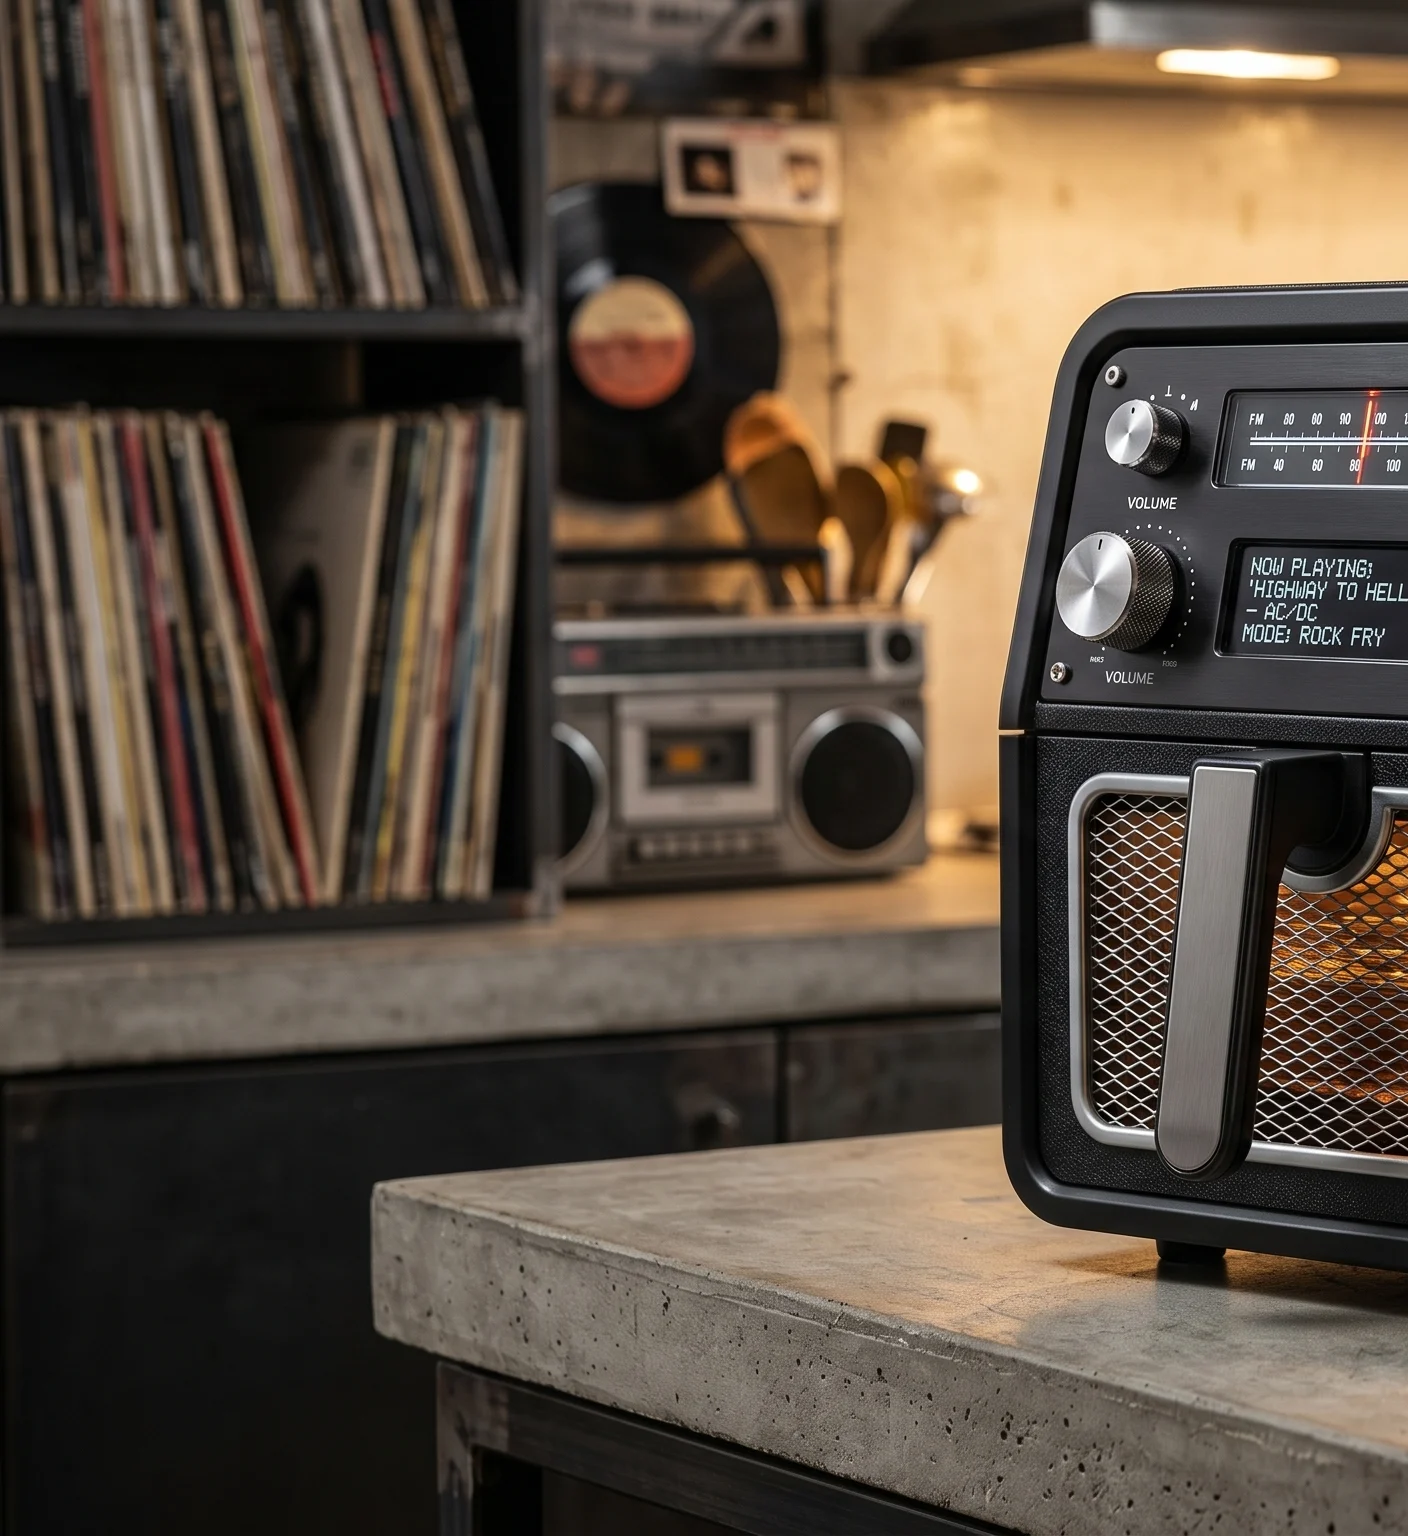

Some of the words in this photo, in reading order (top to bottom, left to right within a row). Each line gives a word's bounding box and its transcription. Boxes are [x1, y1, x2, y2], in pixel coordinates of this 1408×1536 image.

[1249, 413, 1265, 426] FM
[1241, 458, 1256, 471] FM
[1273, 458, 1285, 472] 40
[1311, 458, 1323, 472] 60
[1386, 459, 1401, 472] 100
[1127, 496, 1178, 510] VOLUME
[1250, 557, 1285, 576] NOW
[1250, 579, 1328, 600] 'HIGHWAY
[1337, 582, 1358, 600] TO
[1264, 602, 1319, 622] AC/DC
[1299, 626, 1344, 646] ROCK
[1350, 627, 1386, 647] FRY
[1105, 670, 1155, 685] VOLUME
